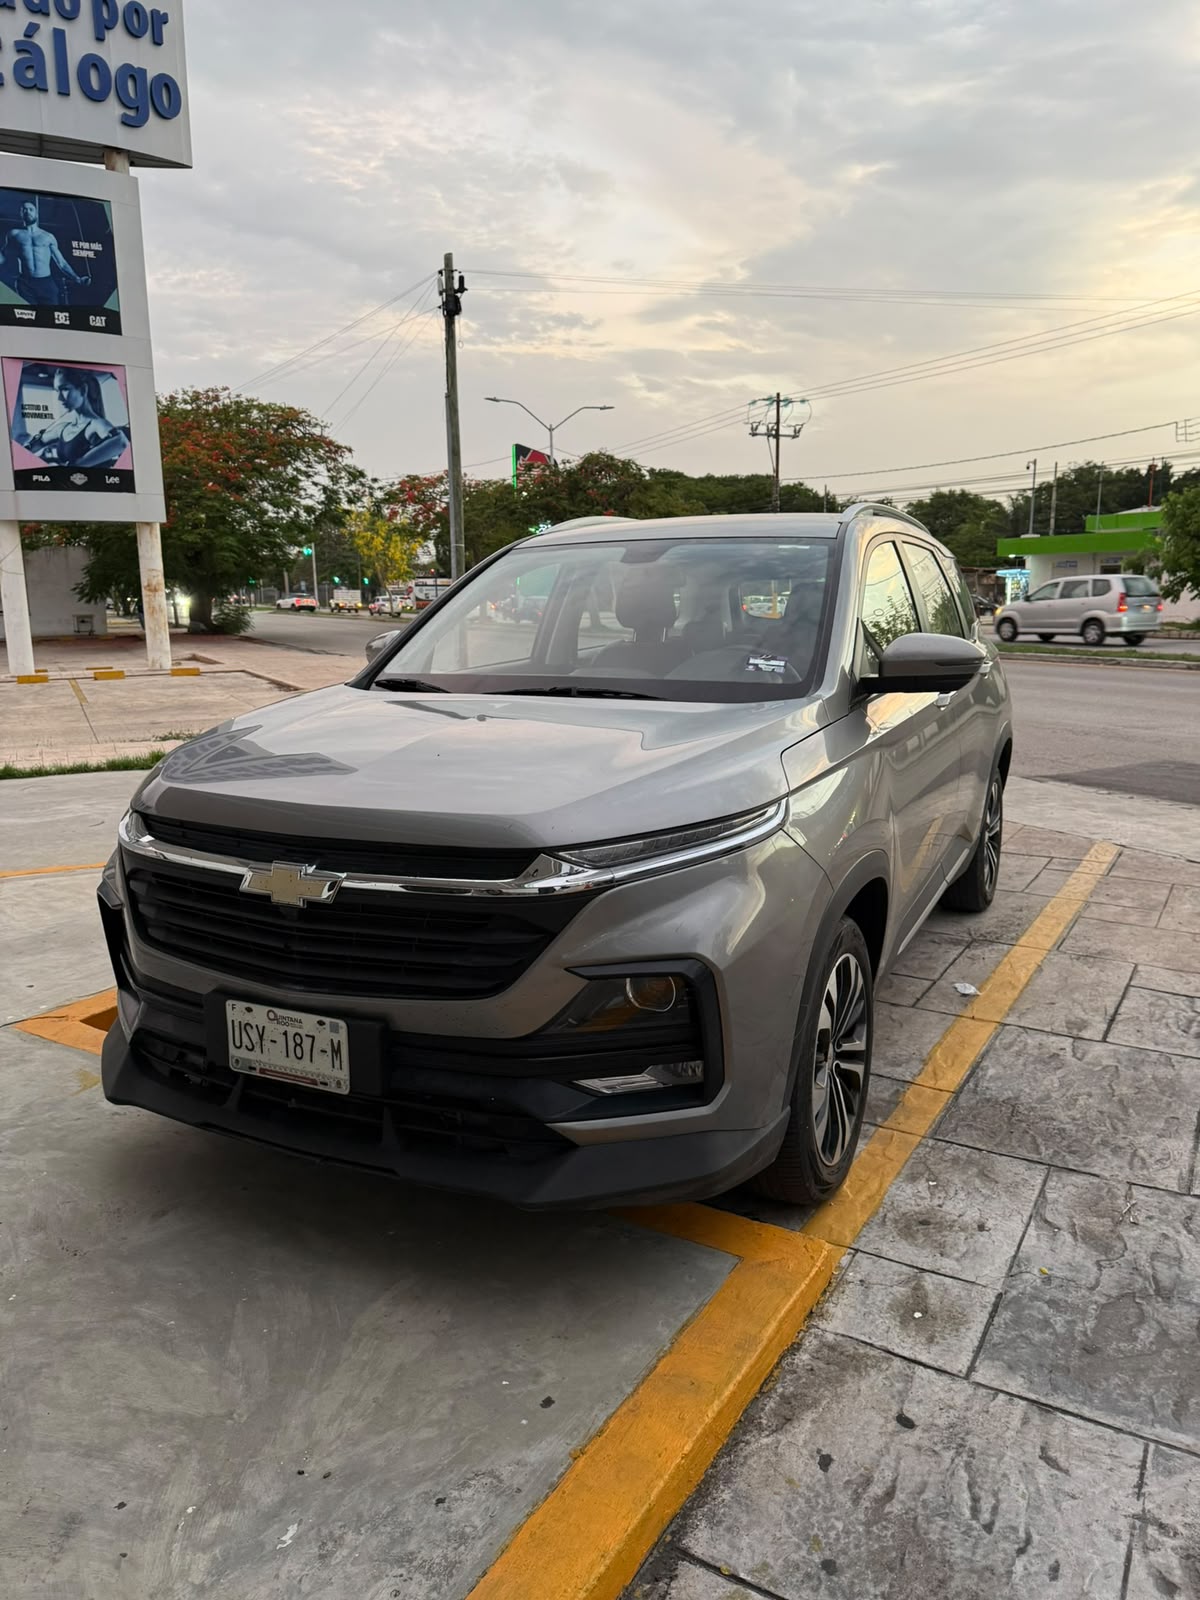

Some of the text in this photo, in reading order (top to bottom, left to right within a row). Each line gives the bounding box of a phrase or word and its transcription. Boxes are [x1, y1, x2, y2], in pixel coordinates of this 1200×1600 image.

[92, 0, 169, 46] por
[0, 22, 182, 128] álogo
[89, 315, 107, 327] CAT
[32, 474, 51, 482] FILA
[105, 475, 120, 484] Lee
[231, 1019, 343, 1071] USY-187-M
